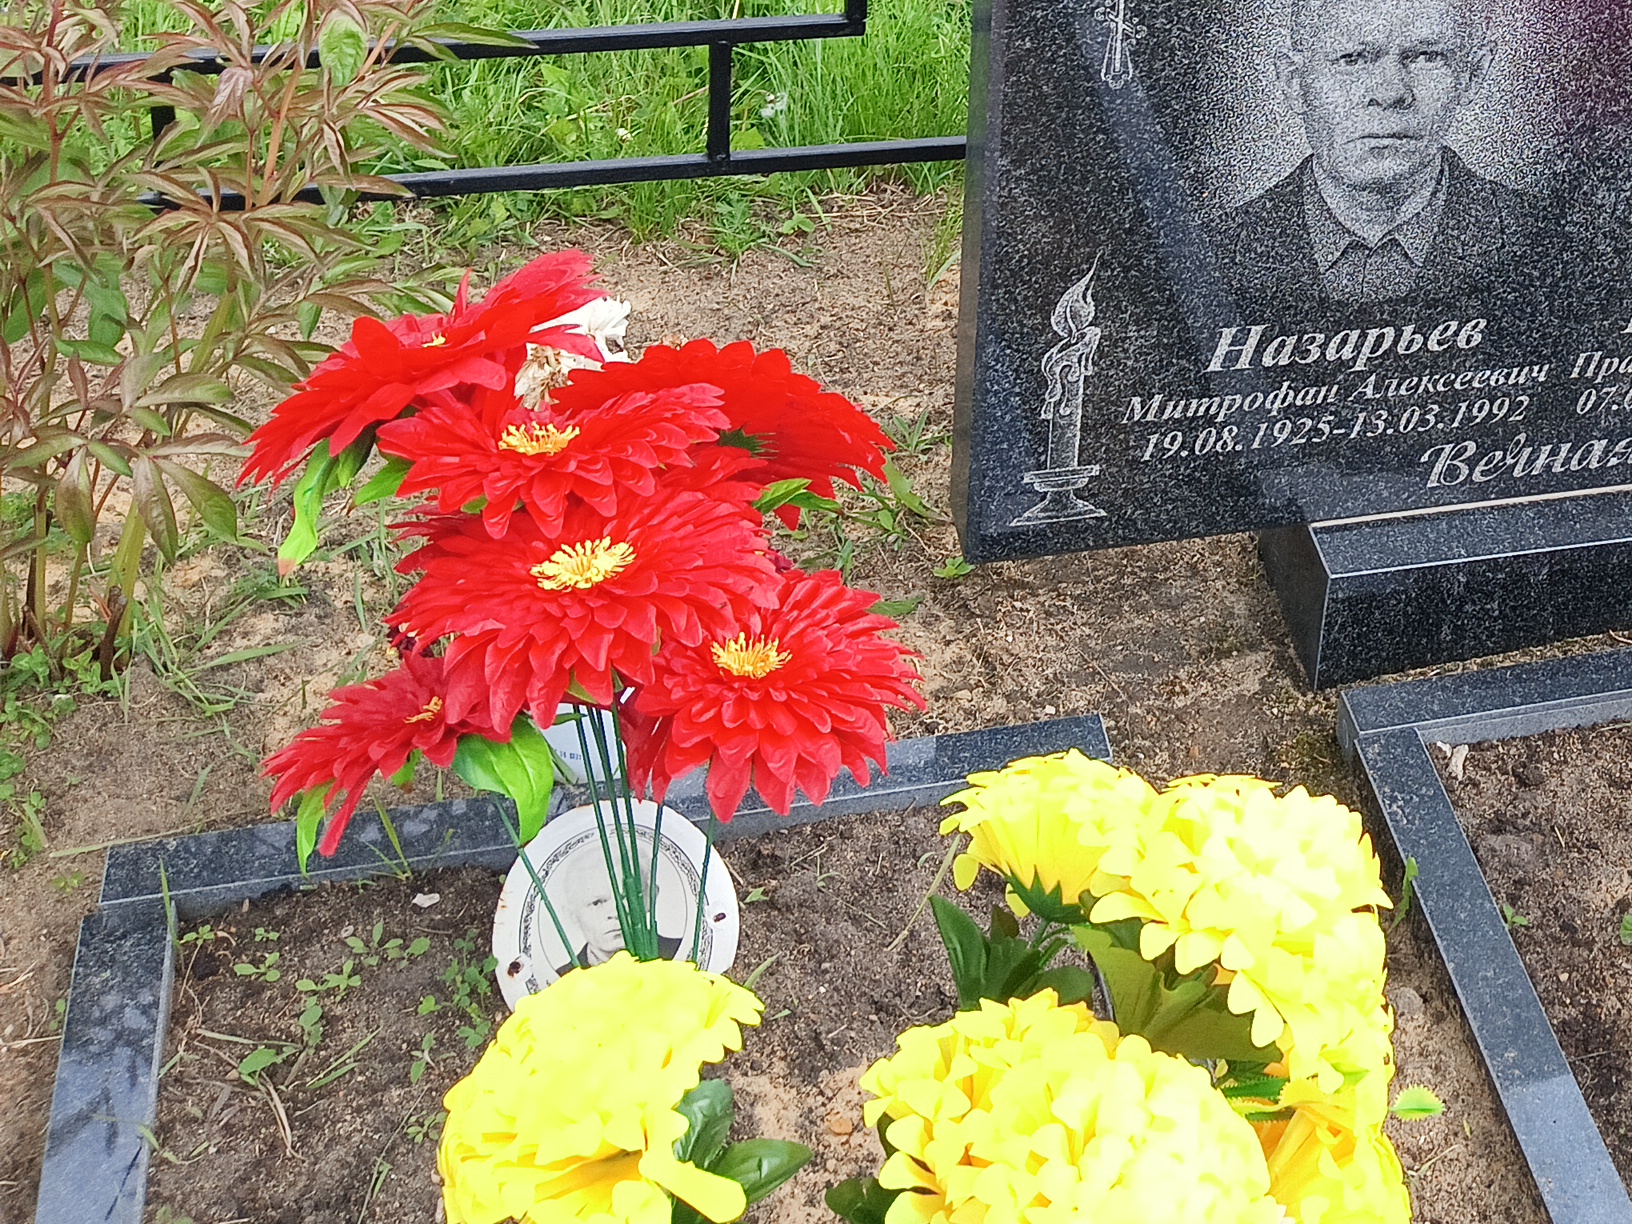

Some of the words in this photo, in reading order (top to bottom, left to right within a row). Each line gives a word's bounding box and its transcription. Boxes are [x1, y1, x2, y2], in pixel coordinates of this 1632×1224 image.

[1203, 319, 1487, 373] Назарьев
[1121, 380, 1340, 424] Митрофан
[1347, 363, 1549, 401] Алексеевич
[1140, 395, 1530, 462] 19.08.1925-13.03.1992
